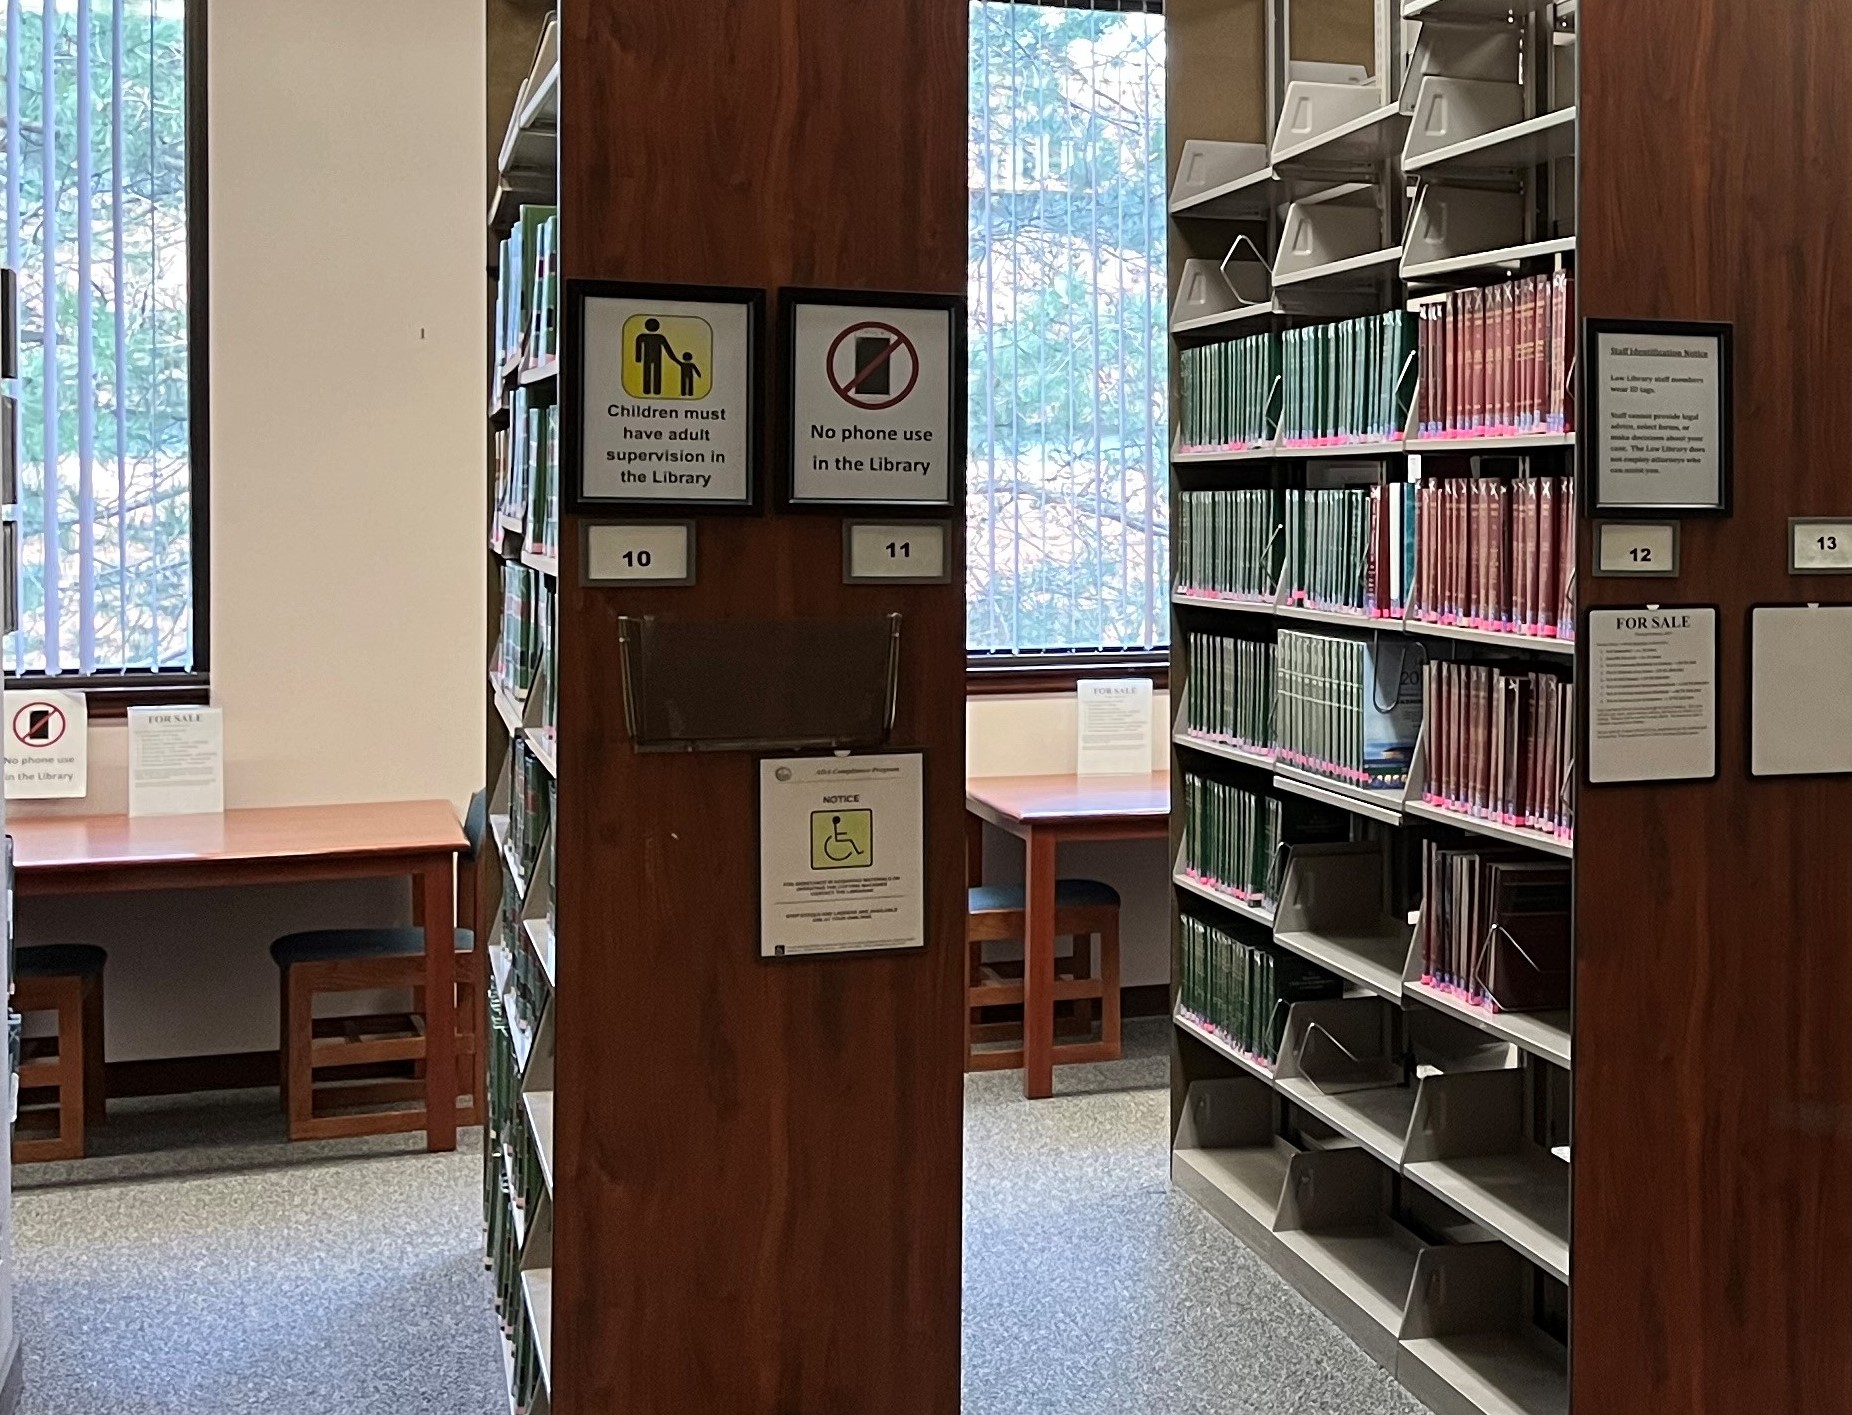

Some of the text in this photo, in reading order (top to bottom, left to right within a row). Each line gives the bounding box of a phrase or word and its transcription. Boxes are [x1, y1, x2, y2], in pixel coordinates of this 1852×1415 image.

[607, 404, 726, 421] Children must
[623, 427, 710, 441] have adult
[811, 425, 933, 443] No phone use
[606, 449, 725, 463] supervision in
[813, 456, 930, 475] in the Library
[620, 471, 711, 487] the Library
[885, 542, 911, 558] 11
[1817, 537, 1837, 550] 13
[623, 550, 651, 567] 10
[1630, 549, 1651, 562] 12
[1616, 616, 1691, 630] FOR SALE
[149, 713, 203, 724] FOR SALE
[22, 756, 55, 765] phone
[38, 772, 73, 782] Library
[823, 794, 859, 803] NOTICE
